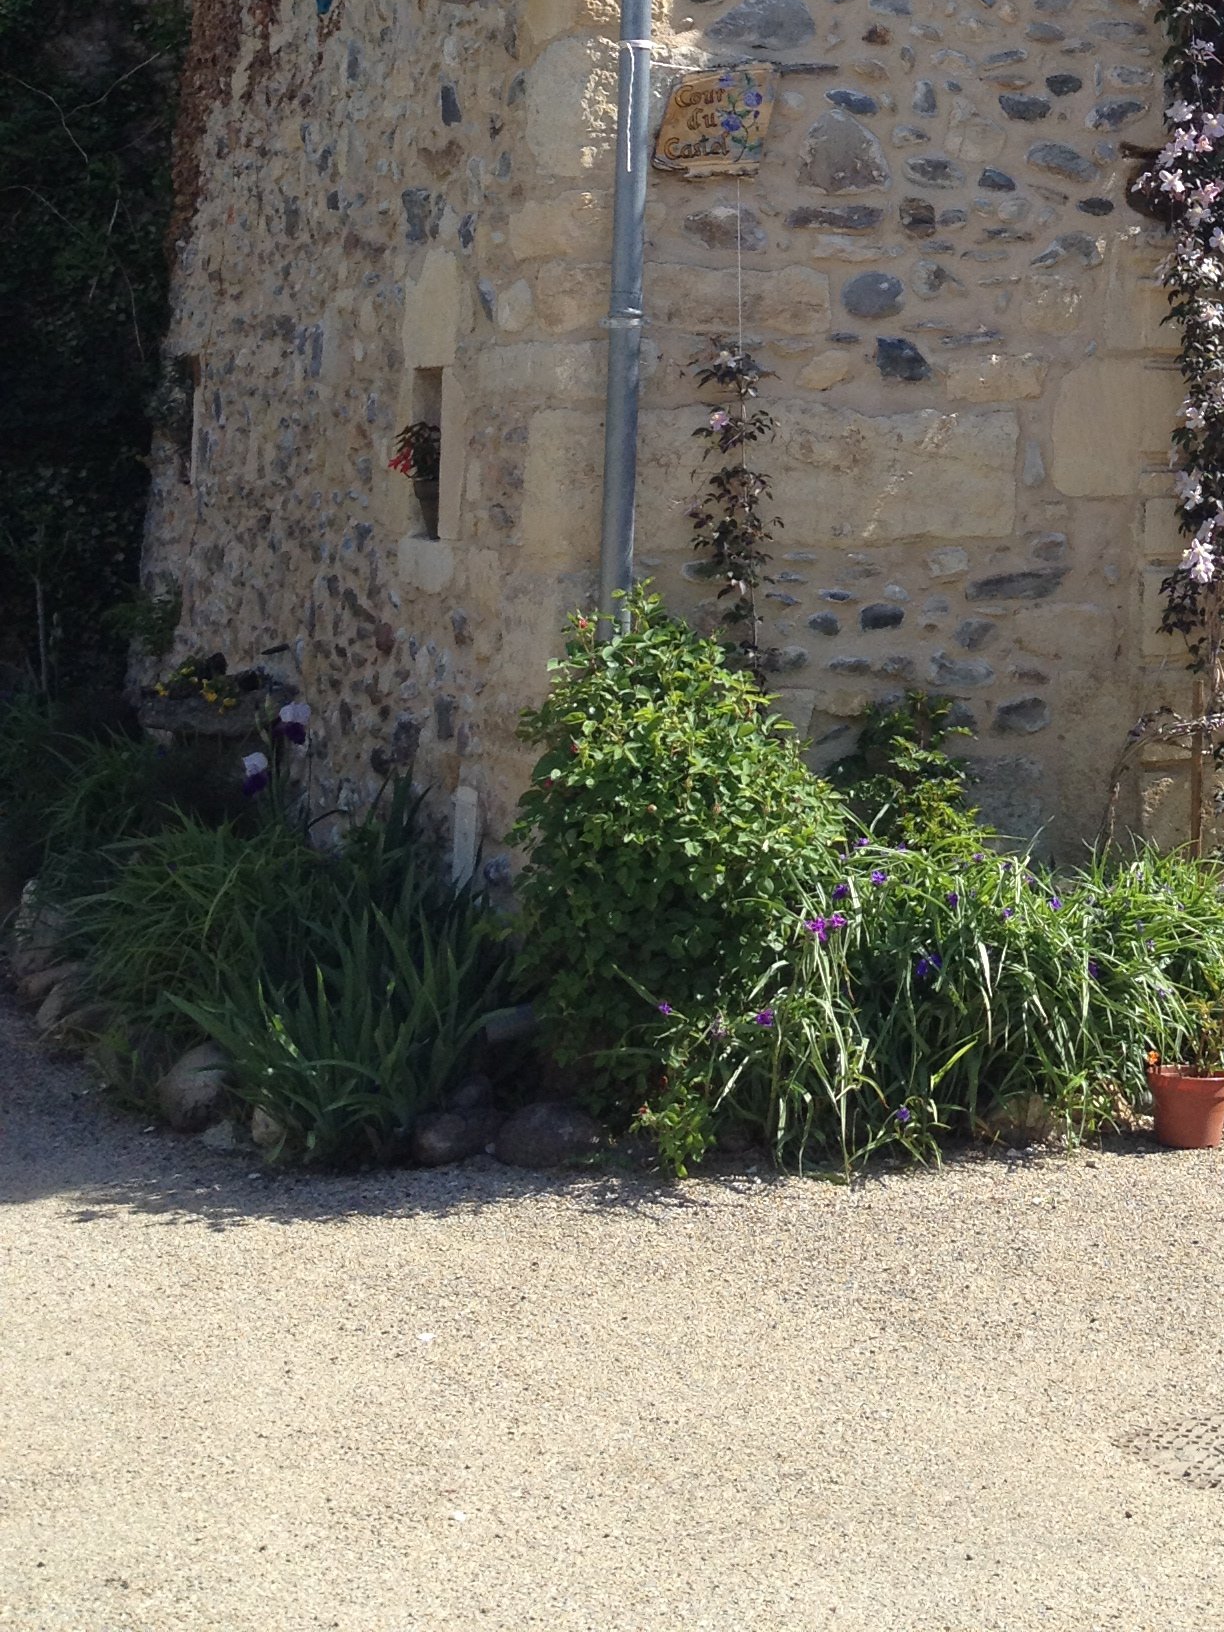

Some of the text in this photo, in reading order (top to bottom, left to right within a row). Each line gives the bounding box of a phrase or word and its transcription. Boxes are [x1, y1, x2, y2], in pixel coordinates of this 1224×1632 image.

[675, 84, 726, 107] Cour
[687, 108, 717, 130] du
[664, 131, 730, 160] Castel
